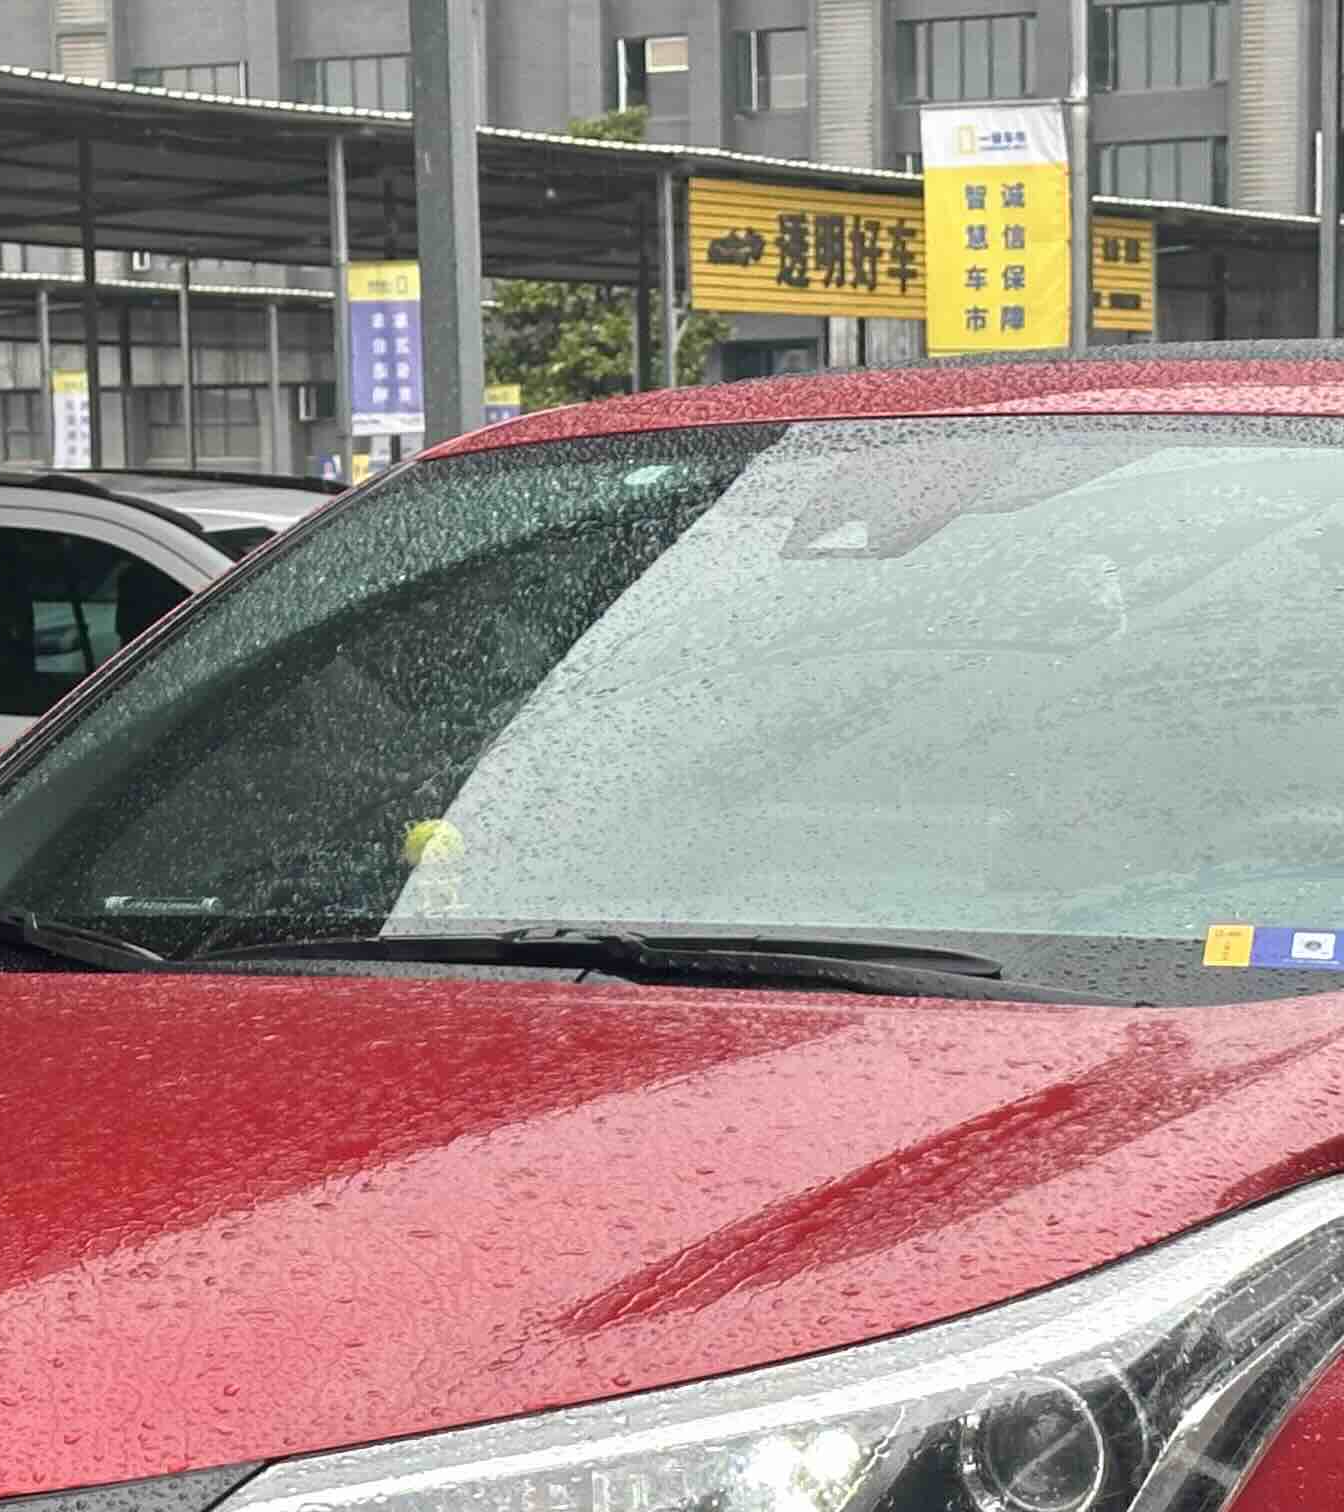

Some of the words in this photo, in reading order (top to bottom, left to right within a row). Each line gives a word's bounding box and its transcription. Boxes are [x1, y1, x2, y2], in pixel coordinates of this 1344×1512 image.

[775, 211, 918, 294] 透明好车
[965, 184, 988, 332] 智慧车市
[1001, 183, 1025, 332] 诚信保障
